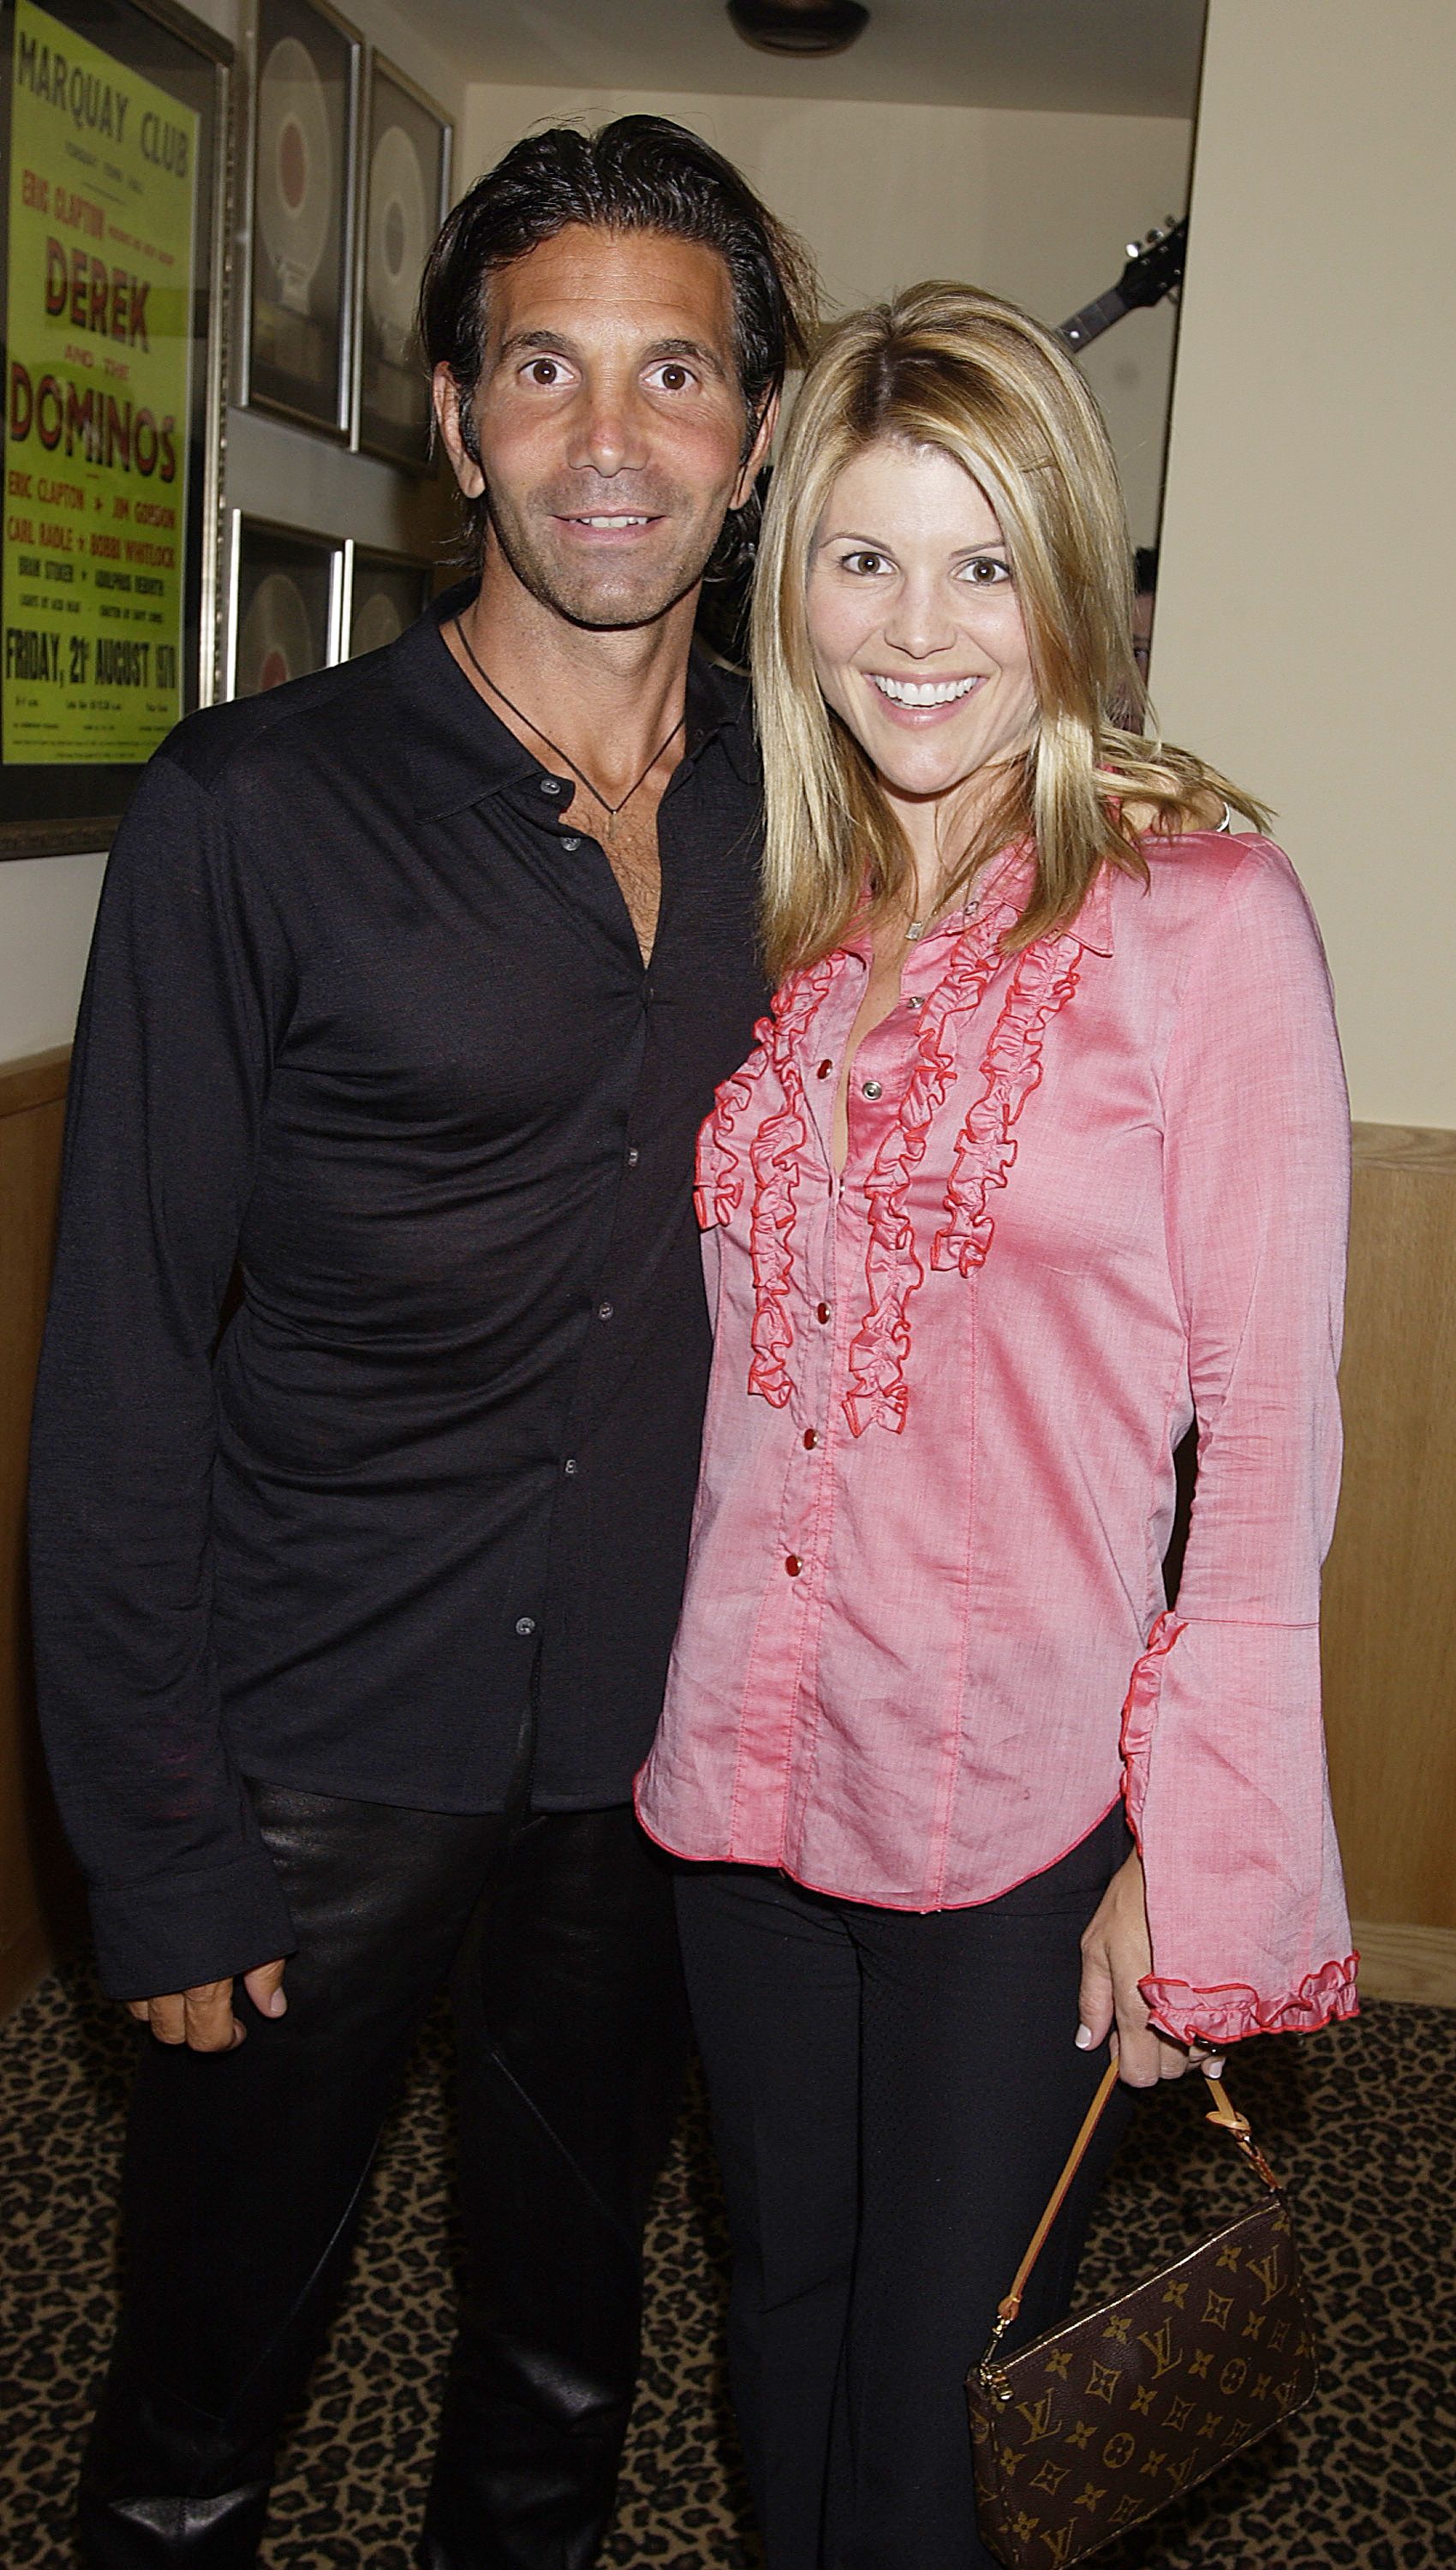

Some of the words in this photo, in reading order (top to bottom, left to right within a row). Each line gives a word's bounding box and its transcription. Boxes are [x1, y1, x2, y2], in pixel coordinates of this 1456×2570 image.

[17, 31, 130, 144] MARQUAY
[140, 111, 188, 178] CLUB
[21, 168, 49, 213] ERIC
[54, 185, 105, 242] CLAPTON
[45, 236, 151, 353] DEREK
[64, 344, 94, 368] AND
[103, 357, 131, 381] THE
[9, 362, 177, 483] DOMINOS
[7, 469, 33, 499] ERIC
[37, 476, 85, 511] CLAPTON
[5, 627, 64, 689] FRIDAY,
[95, 637, 152, 688] AUGUST
